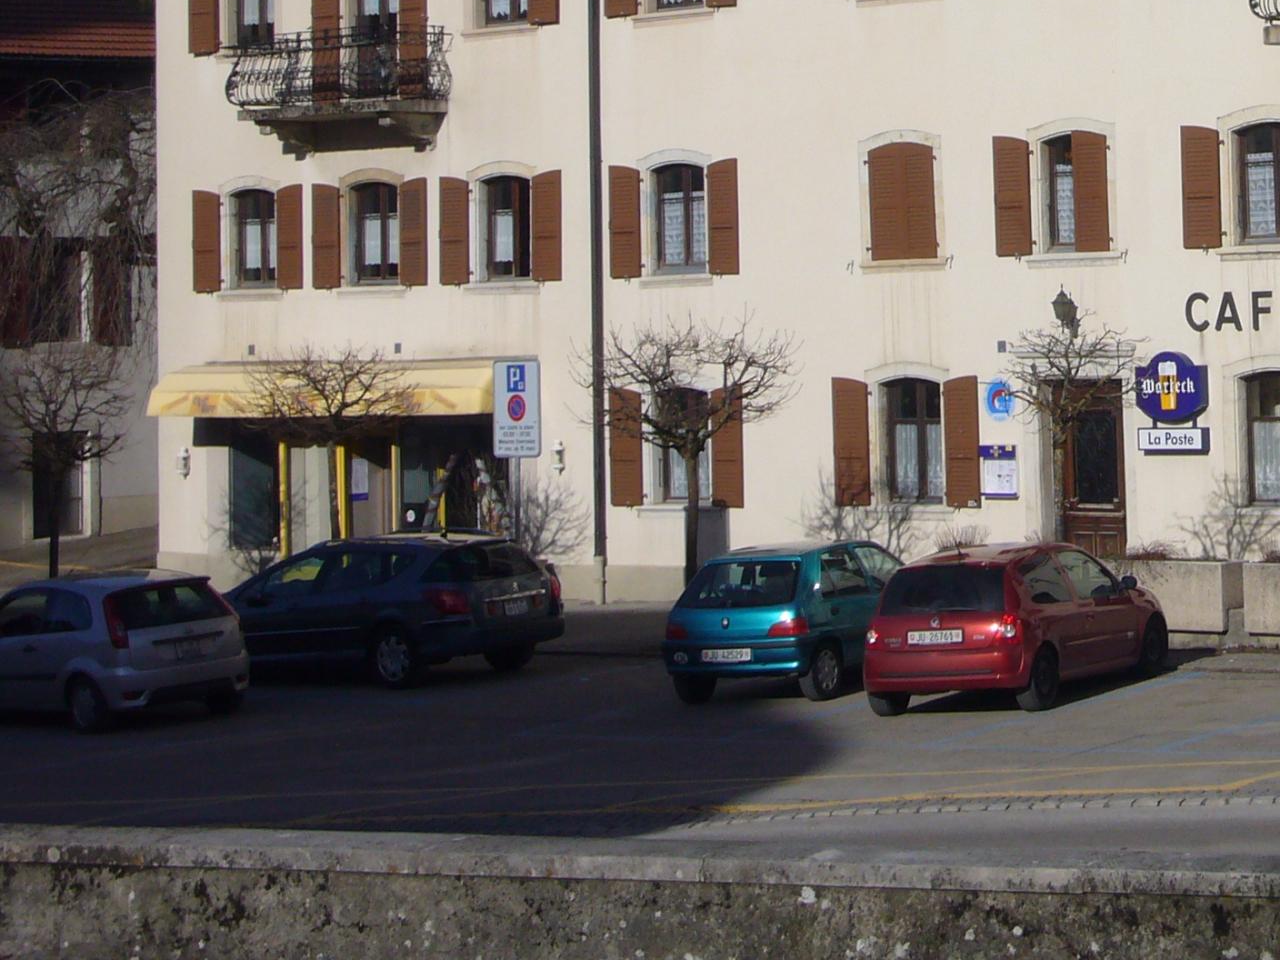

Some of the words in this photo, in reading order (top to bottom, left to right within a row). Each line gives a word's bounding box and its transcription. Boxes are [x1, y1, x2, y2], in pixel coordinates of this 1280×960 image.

[1142, 377, 1195, 399] Warteck
[1148, 432, 1161, 445] La
[1165, 431, 1194, 445] Poste
